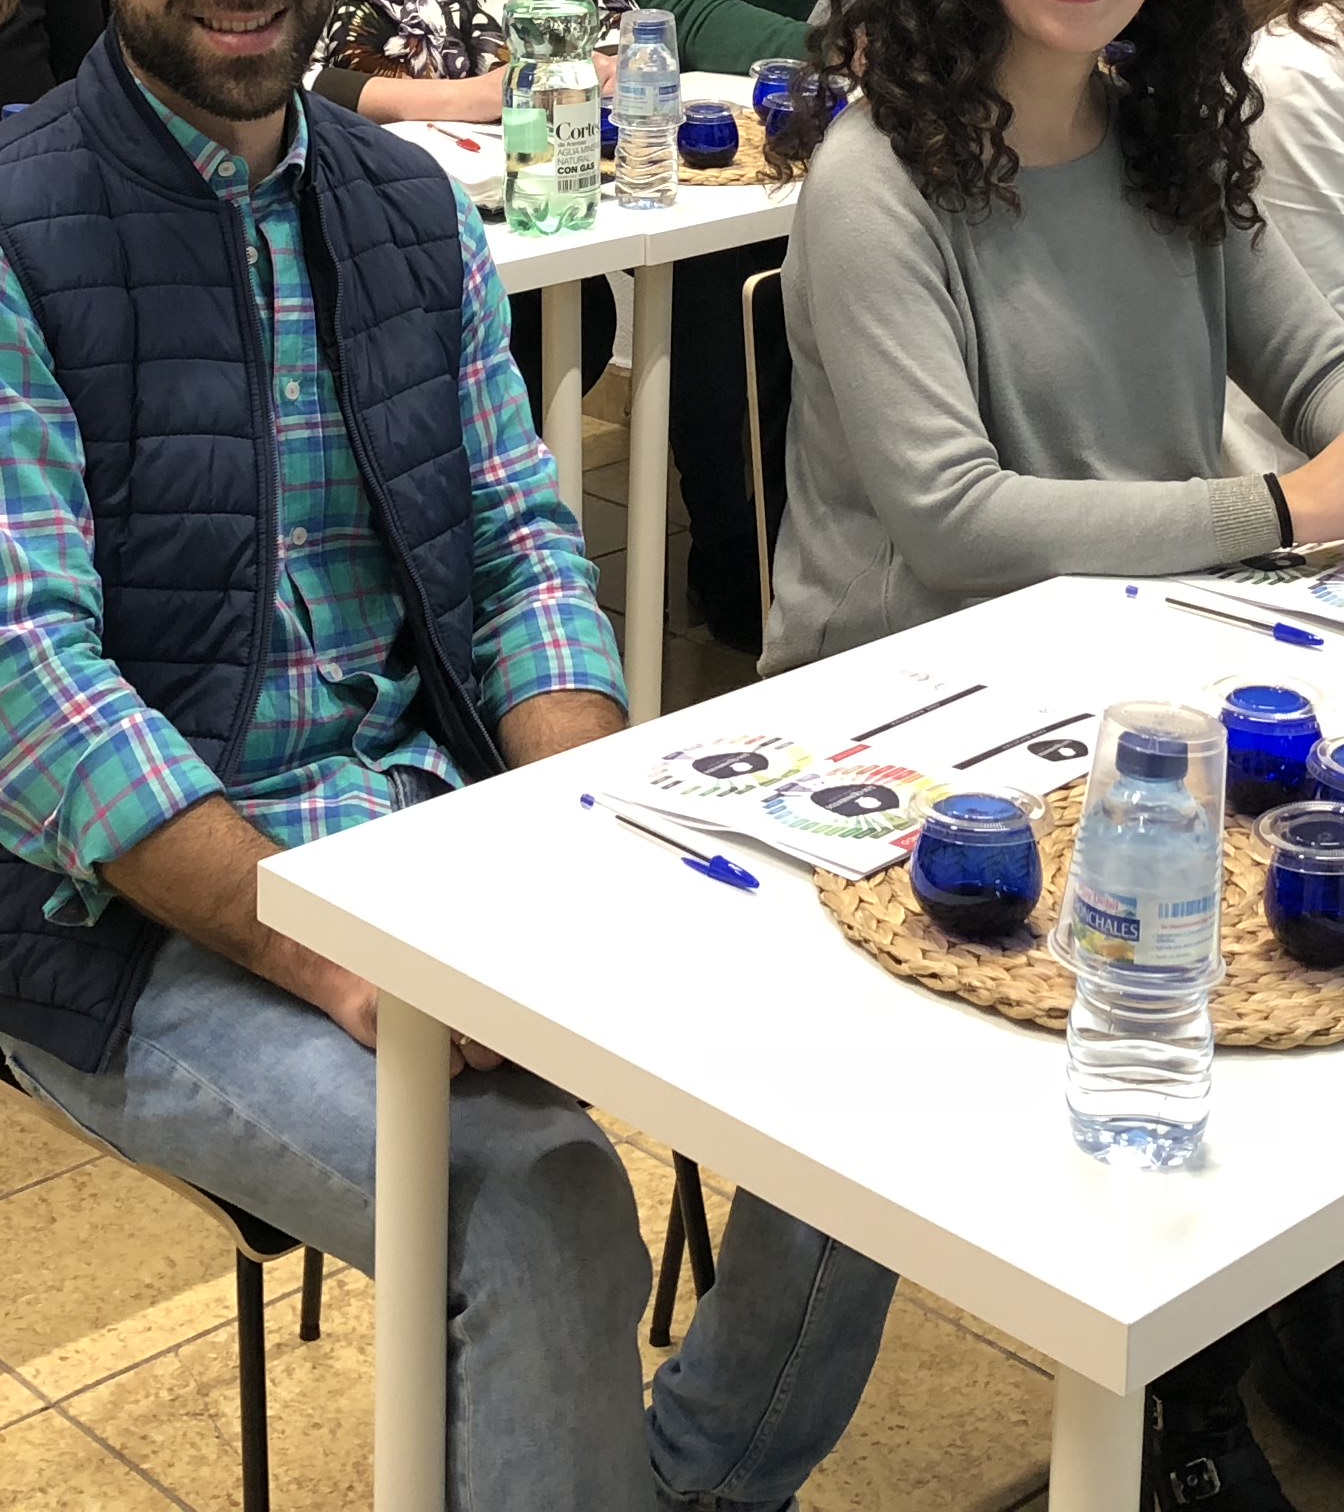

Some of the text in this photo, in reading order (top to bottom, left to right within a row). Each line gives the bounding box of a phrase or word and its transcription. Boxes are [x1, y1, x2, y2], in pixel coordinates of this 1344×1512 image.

[557, 147, 579, 156] AGUA
[557, 166, 578, 175] CON
[580, 161, 595, 173] GAS
